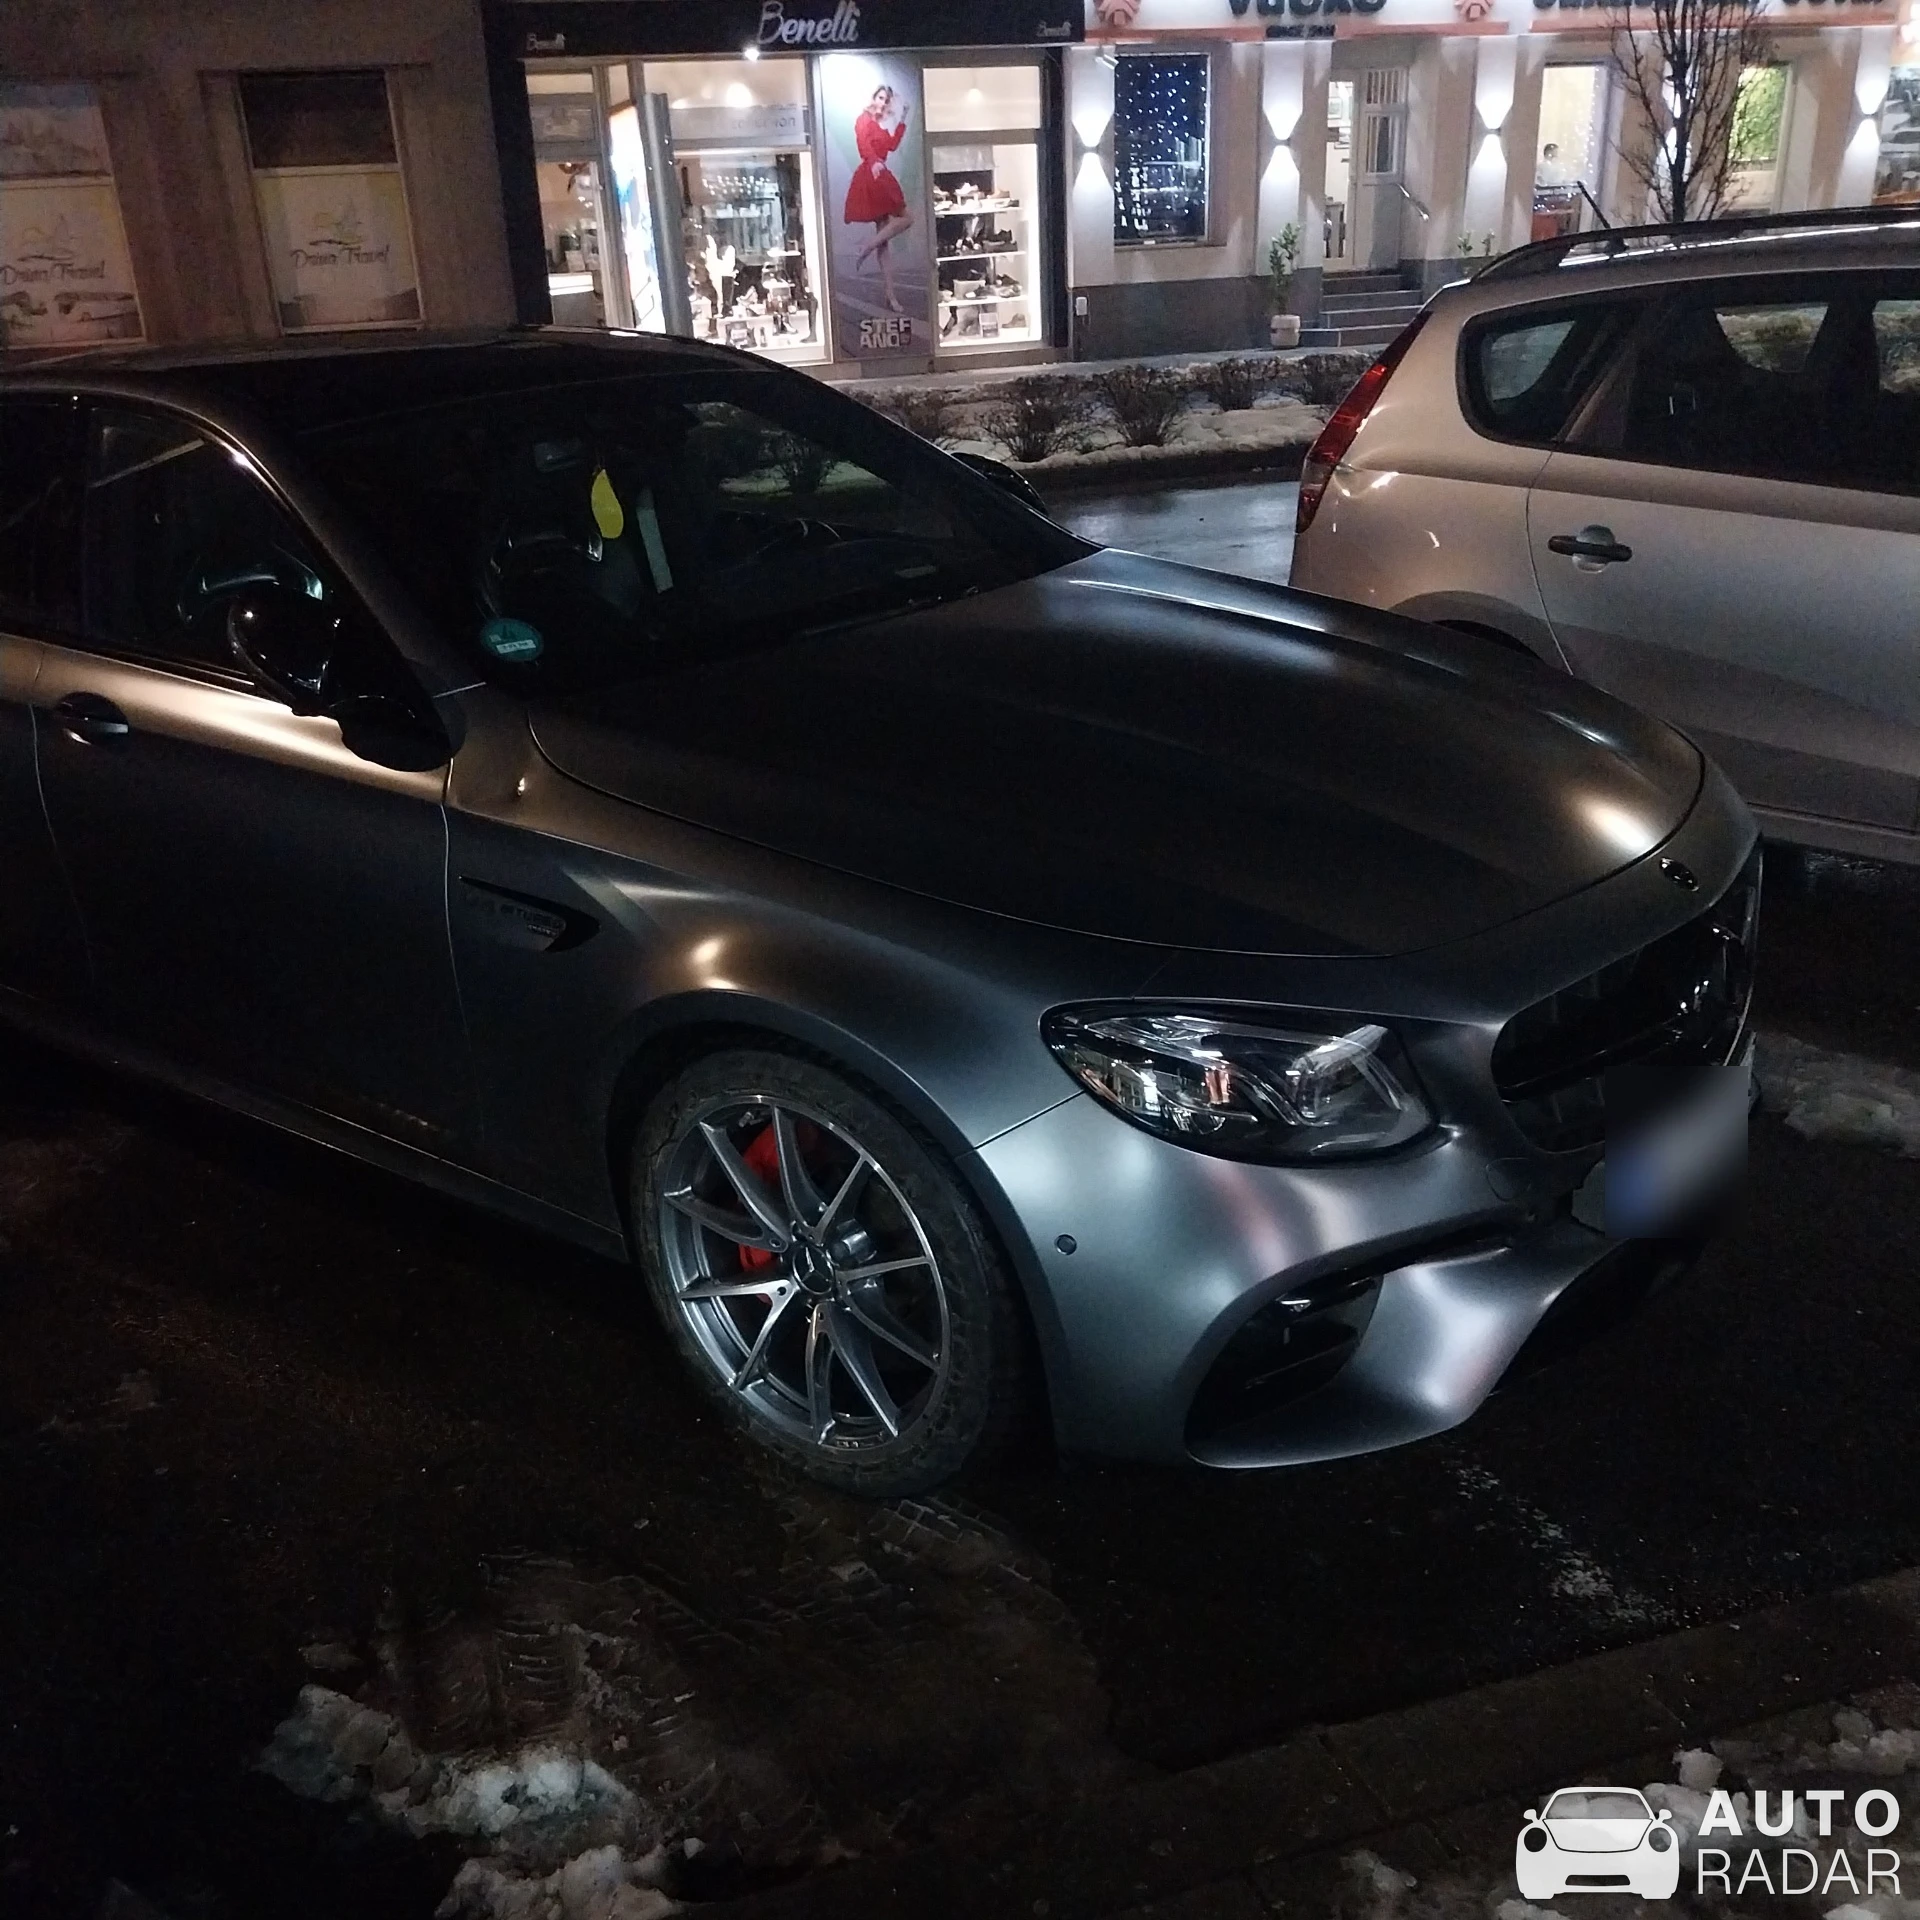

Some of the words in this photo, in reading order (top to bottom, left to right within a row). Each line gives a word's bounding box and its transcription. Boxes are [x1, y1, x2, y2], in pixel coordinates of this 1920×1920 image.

[757, 0, 861, 44] Benelli
[860, 317, 912, 333] STEF
[860, 333, 900, 348] ANO
